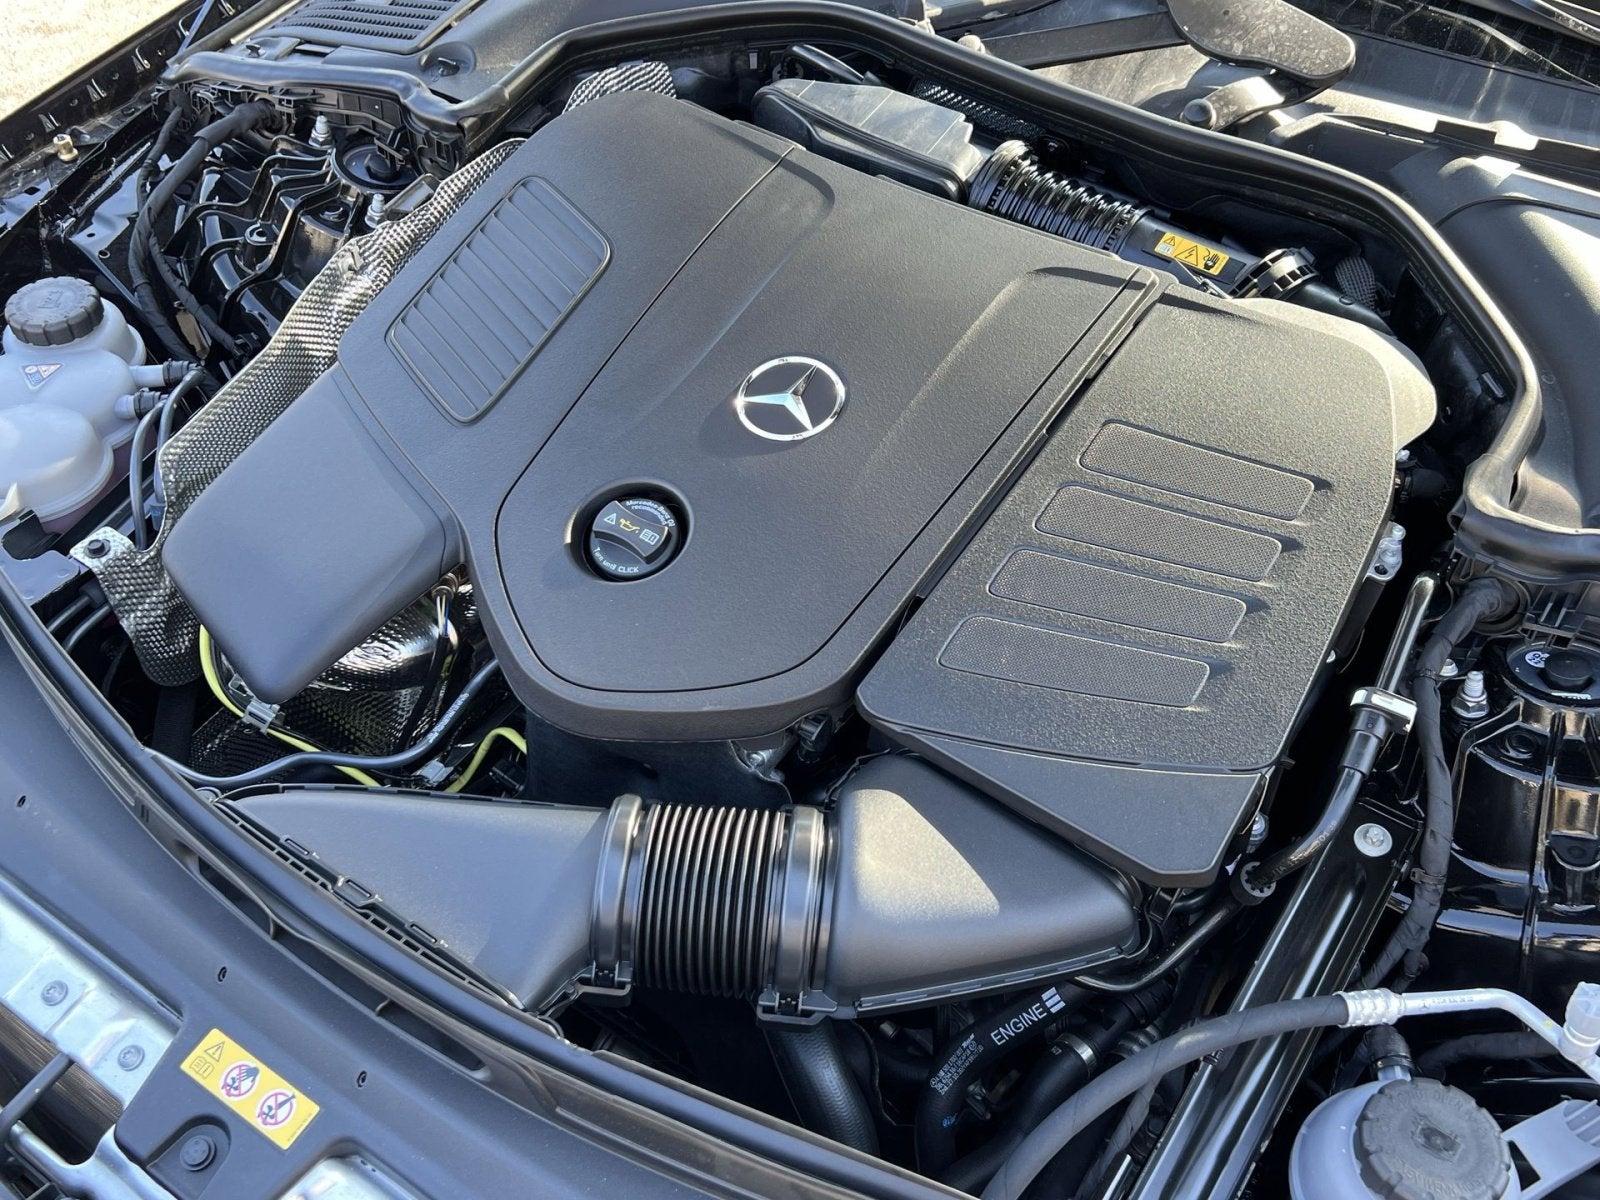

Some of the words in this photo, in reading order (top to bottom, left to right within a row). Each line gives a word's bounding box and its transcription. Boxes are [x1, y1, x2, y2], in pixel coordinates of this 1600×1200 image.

[594, 546, 604, 562] Turn
[602, 560, 617, 570] until
[991, 1003, 1047, 1045] ENGINE
